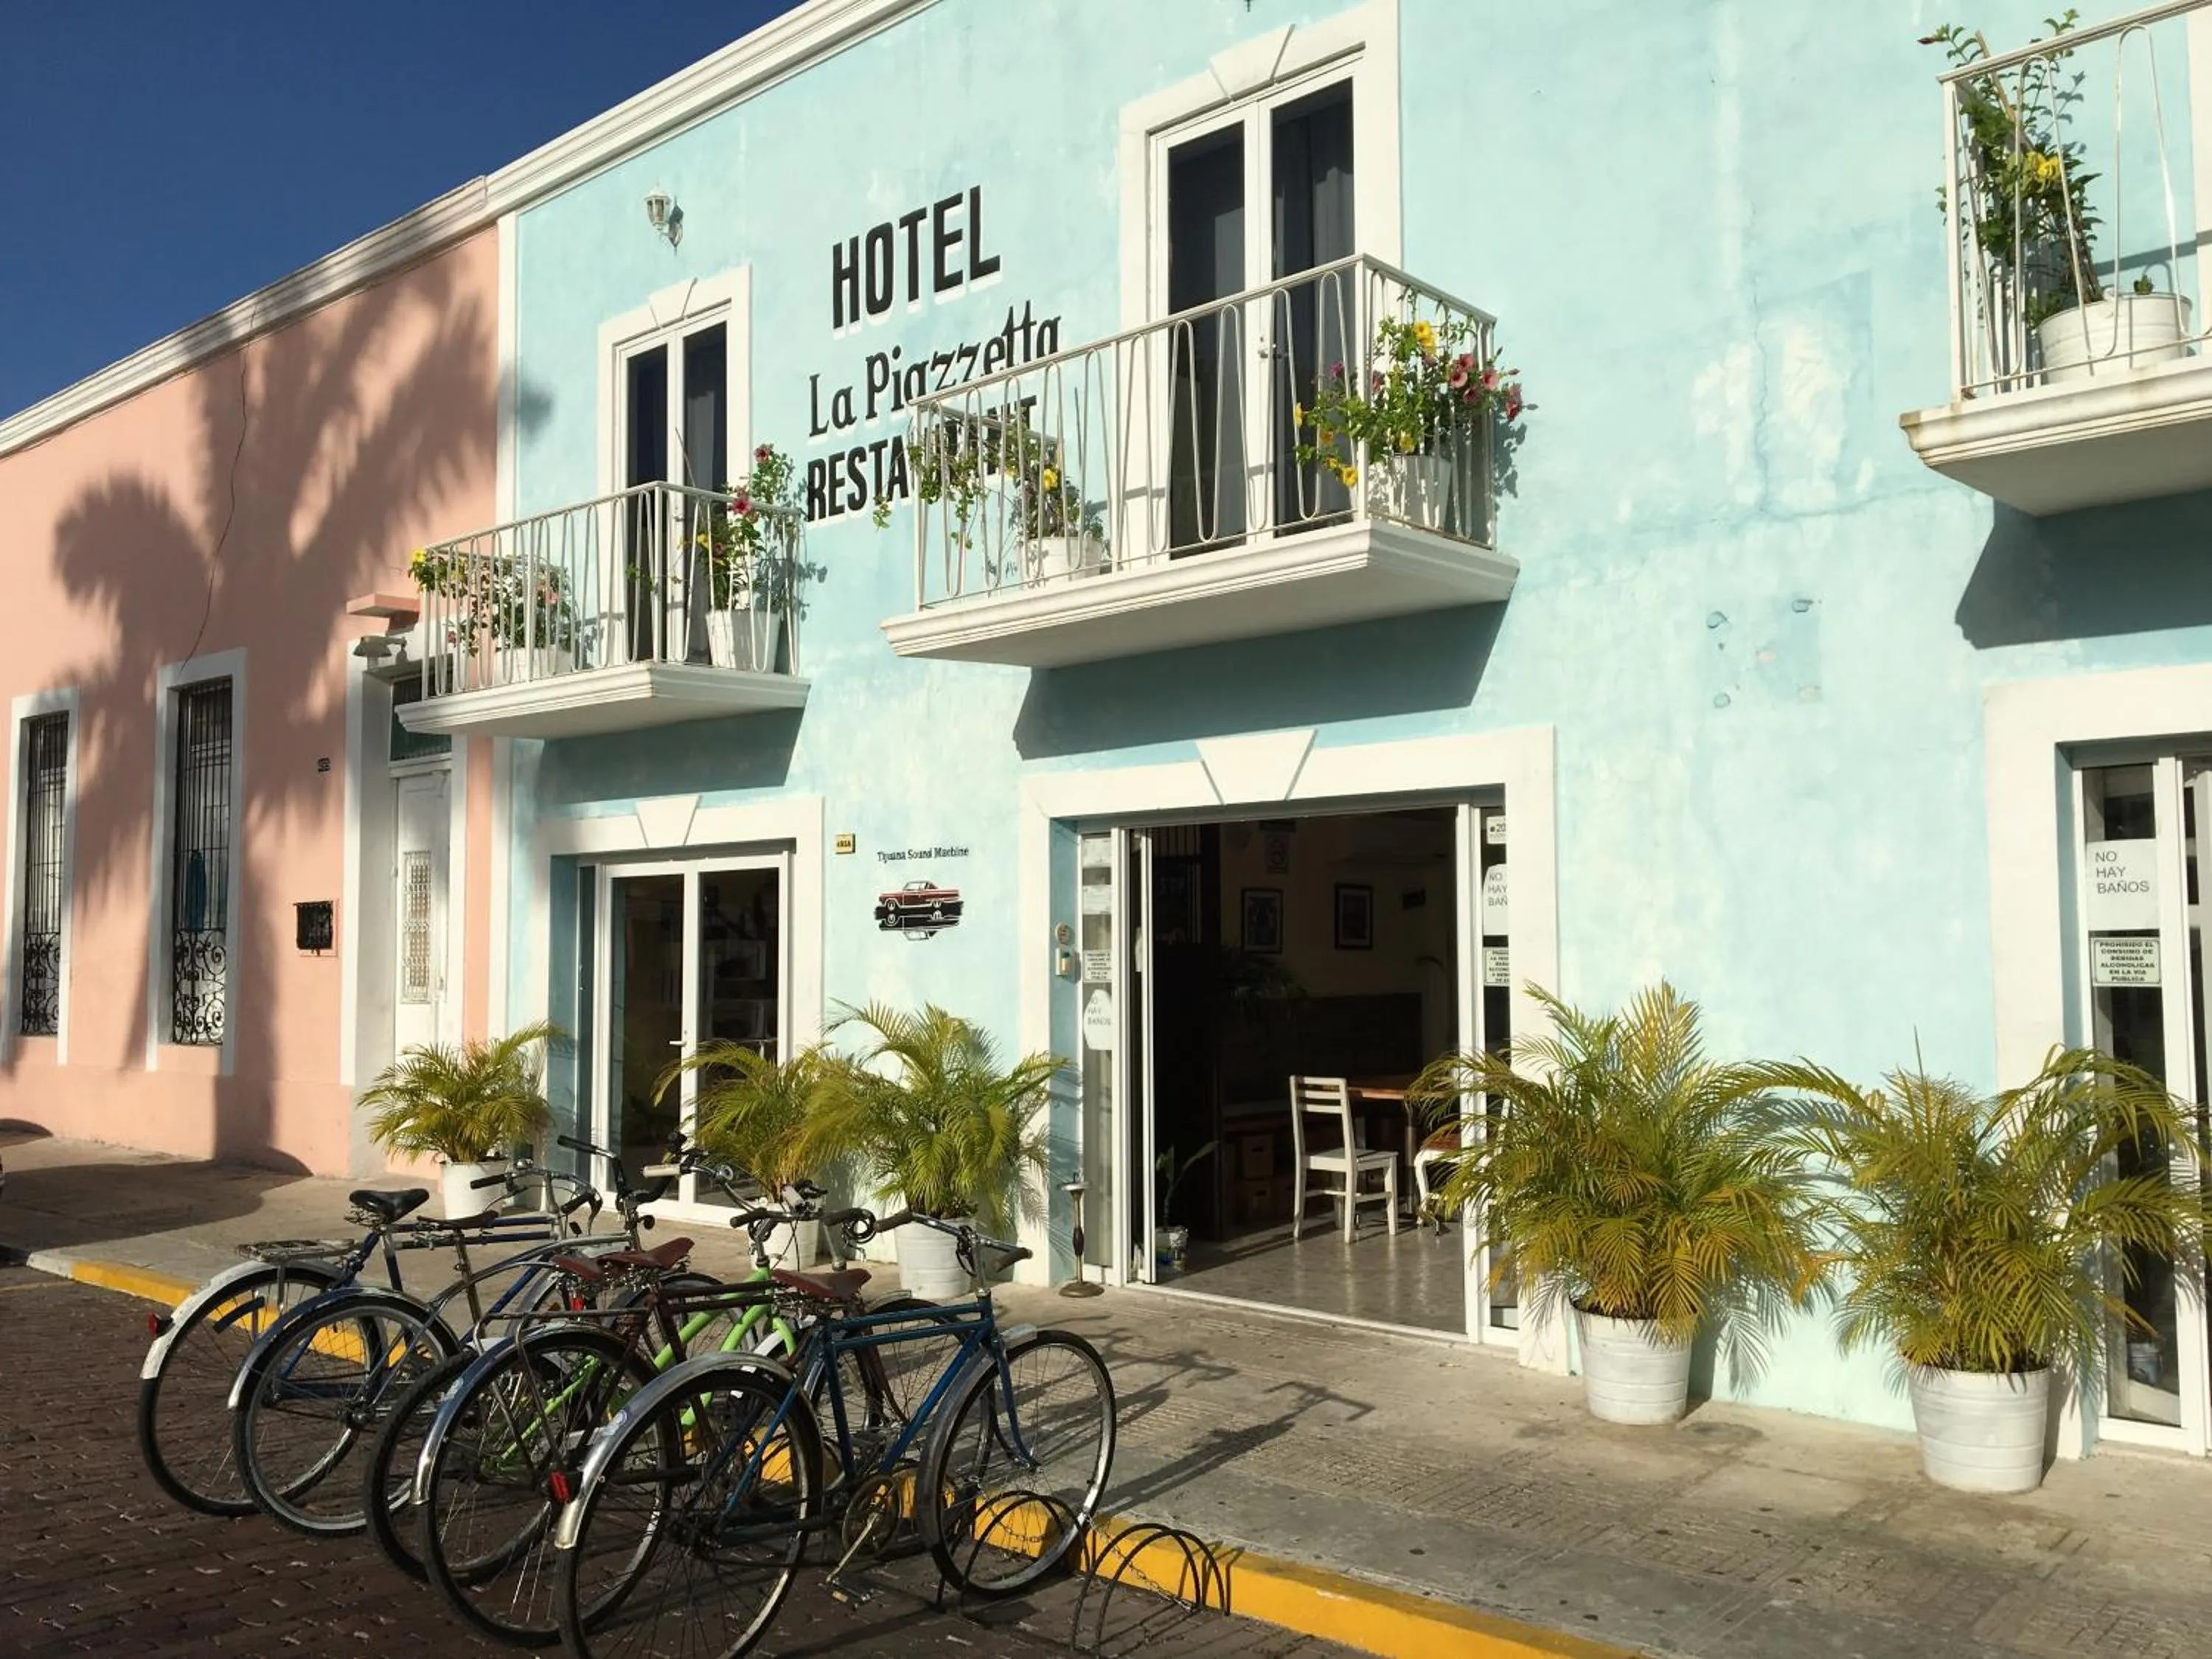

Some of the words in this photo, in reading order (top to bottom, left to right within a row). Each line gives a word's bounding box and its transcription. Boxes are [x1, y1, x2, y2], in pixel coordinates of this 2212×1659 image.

[832, 184, 1001, 330] HOTEL
[809, 373, 857, 437] La
[866, 299, 1062, 420] Piazzetta
[908, 849, 933, 860] Sound
[933, 846, 969, 858] Machine
[2096, 851, 2118, 862] NO
[1489, 872, 1503, 882] NO
[2096, 866, 2126, 878] HAY
[1488, 884, 1508, 894] HAY
[2097, 880, 2151, 894] BAÑOS
